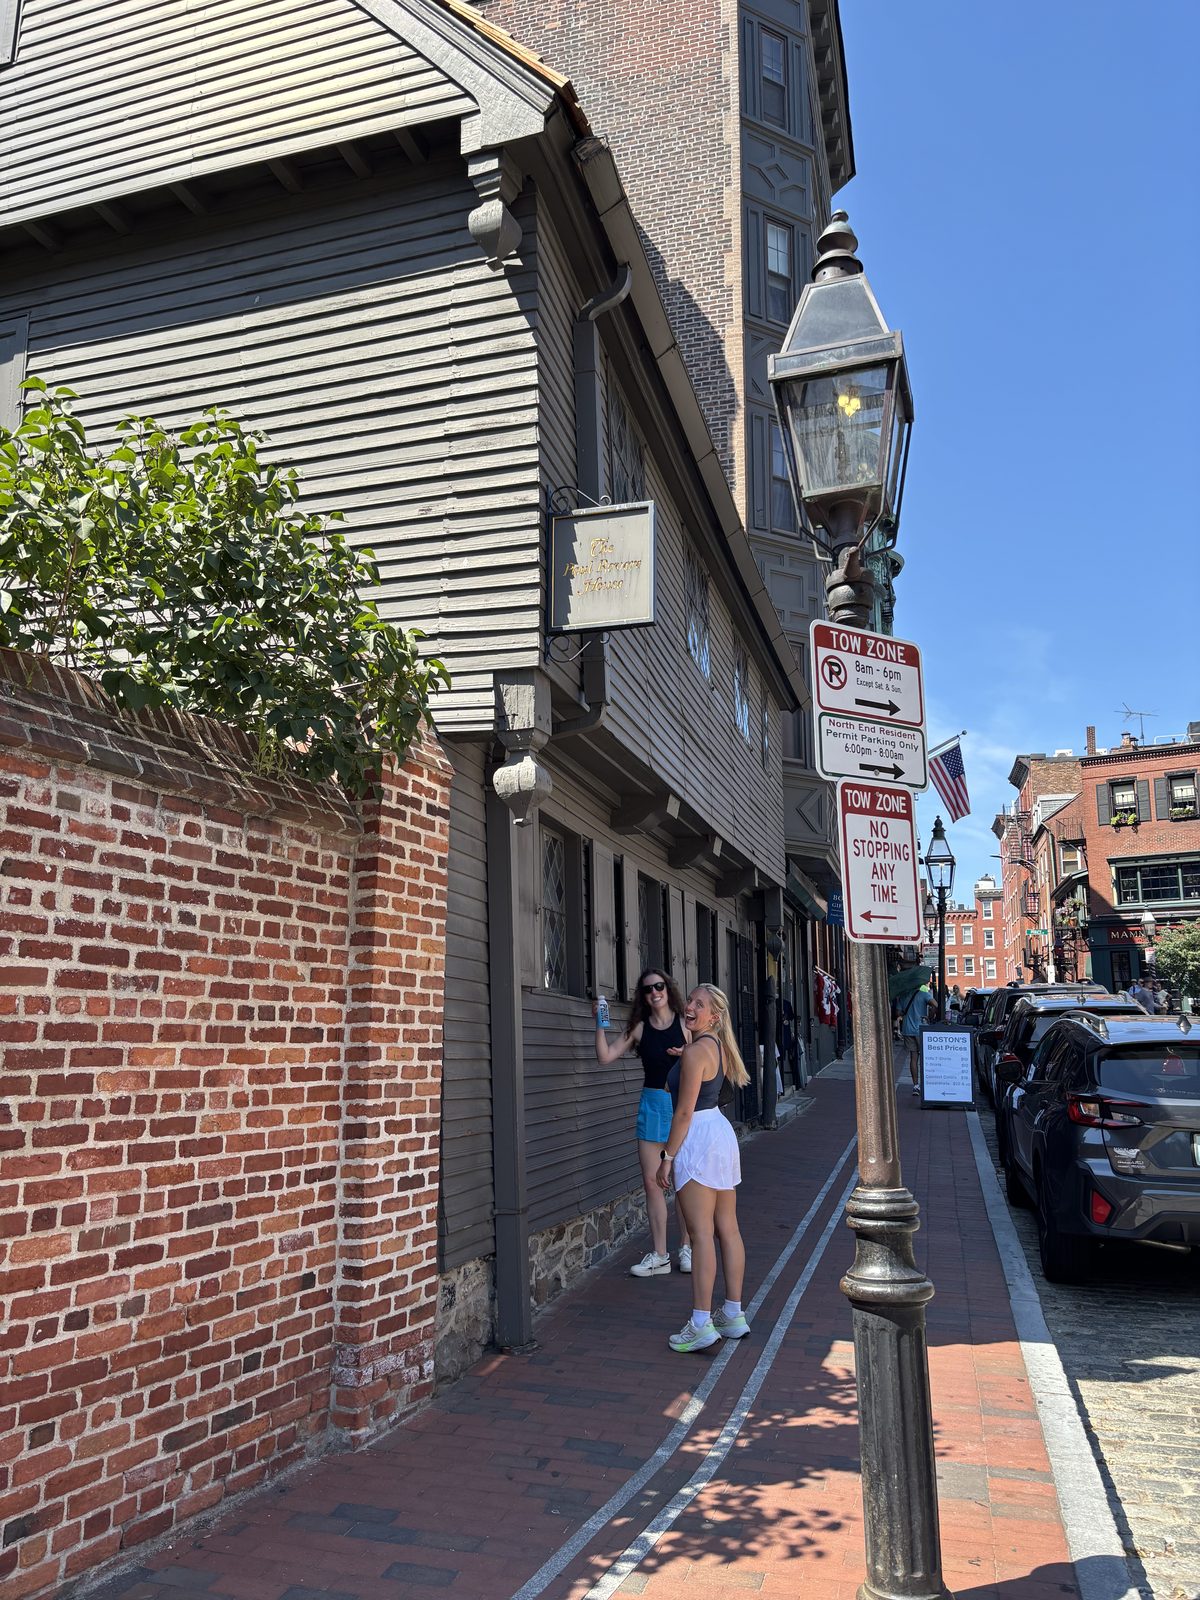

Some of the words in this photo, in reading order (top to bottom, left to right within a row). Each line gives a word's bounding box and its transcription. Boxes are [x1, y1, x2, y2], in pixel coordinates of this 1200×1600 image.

[590, 537, 615, 557] The
[576, 577, 624, 598] House
[829, 630, 861, 654] TOW
[866, 639, 906, 663] ZONE
[855, 660, 874, 675] 8am
[883, 667, 902, 681] 6pm
[856, 678, 874, 689] Except
[875, 682, 884, 690] Sat.
[892, 685, 902, 693] Sun.
[828, 718, 855, 730] North
[858, 724, 876, 733] End
[880, 727, 916, 740] Resident
[826, 729, 858, 741] Permit
[861, 734, 896, 749] Parking
[899, 740, 919, 752] Only
[844, 743, 872, 756] 6:00pm
[879, 748, 904, 760] 8:00am
[844, 789, 871, 809] TOW
[875, 792, 907, 814] ZONE
[870, 820, 889, 839] NO
[853, 838, 910, 861] STOPPING
[871, 862, 896, 881] ANY
[870, 883, 898, 904] TIME
[927, 1036, 967, 1044] BOSTON'S
